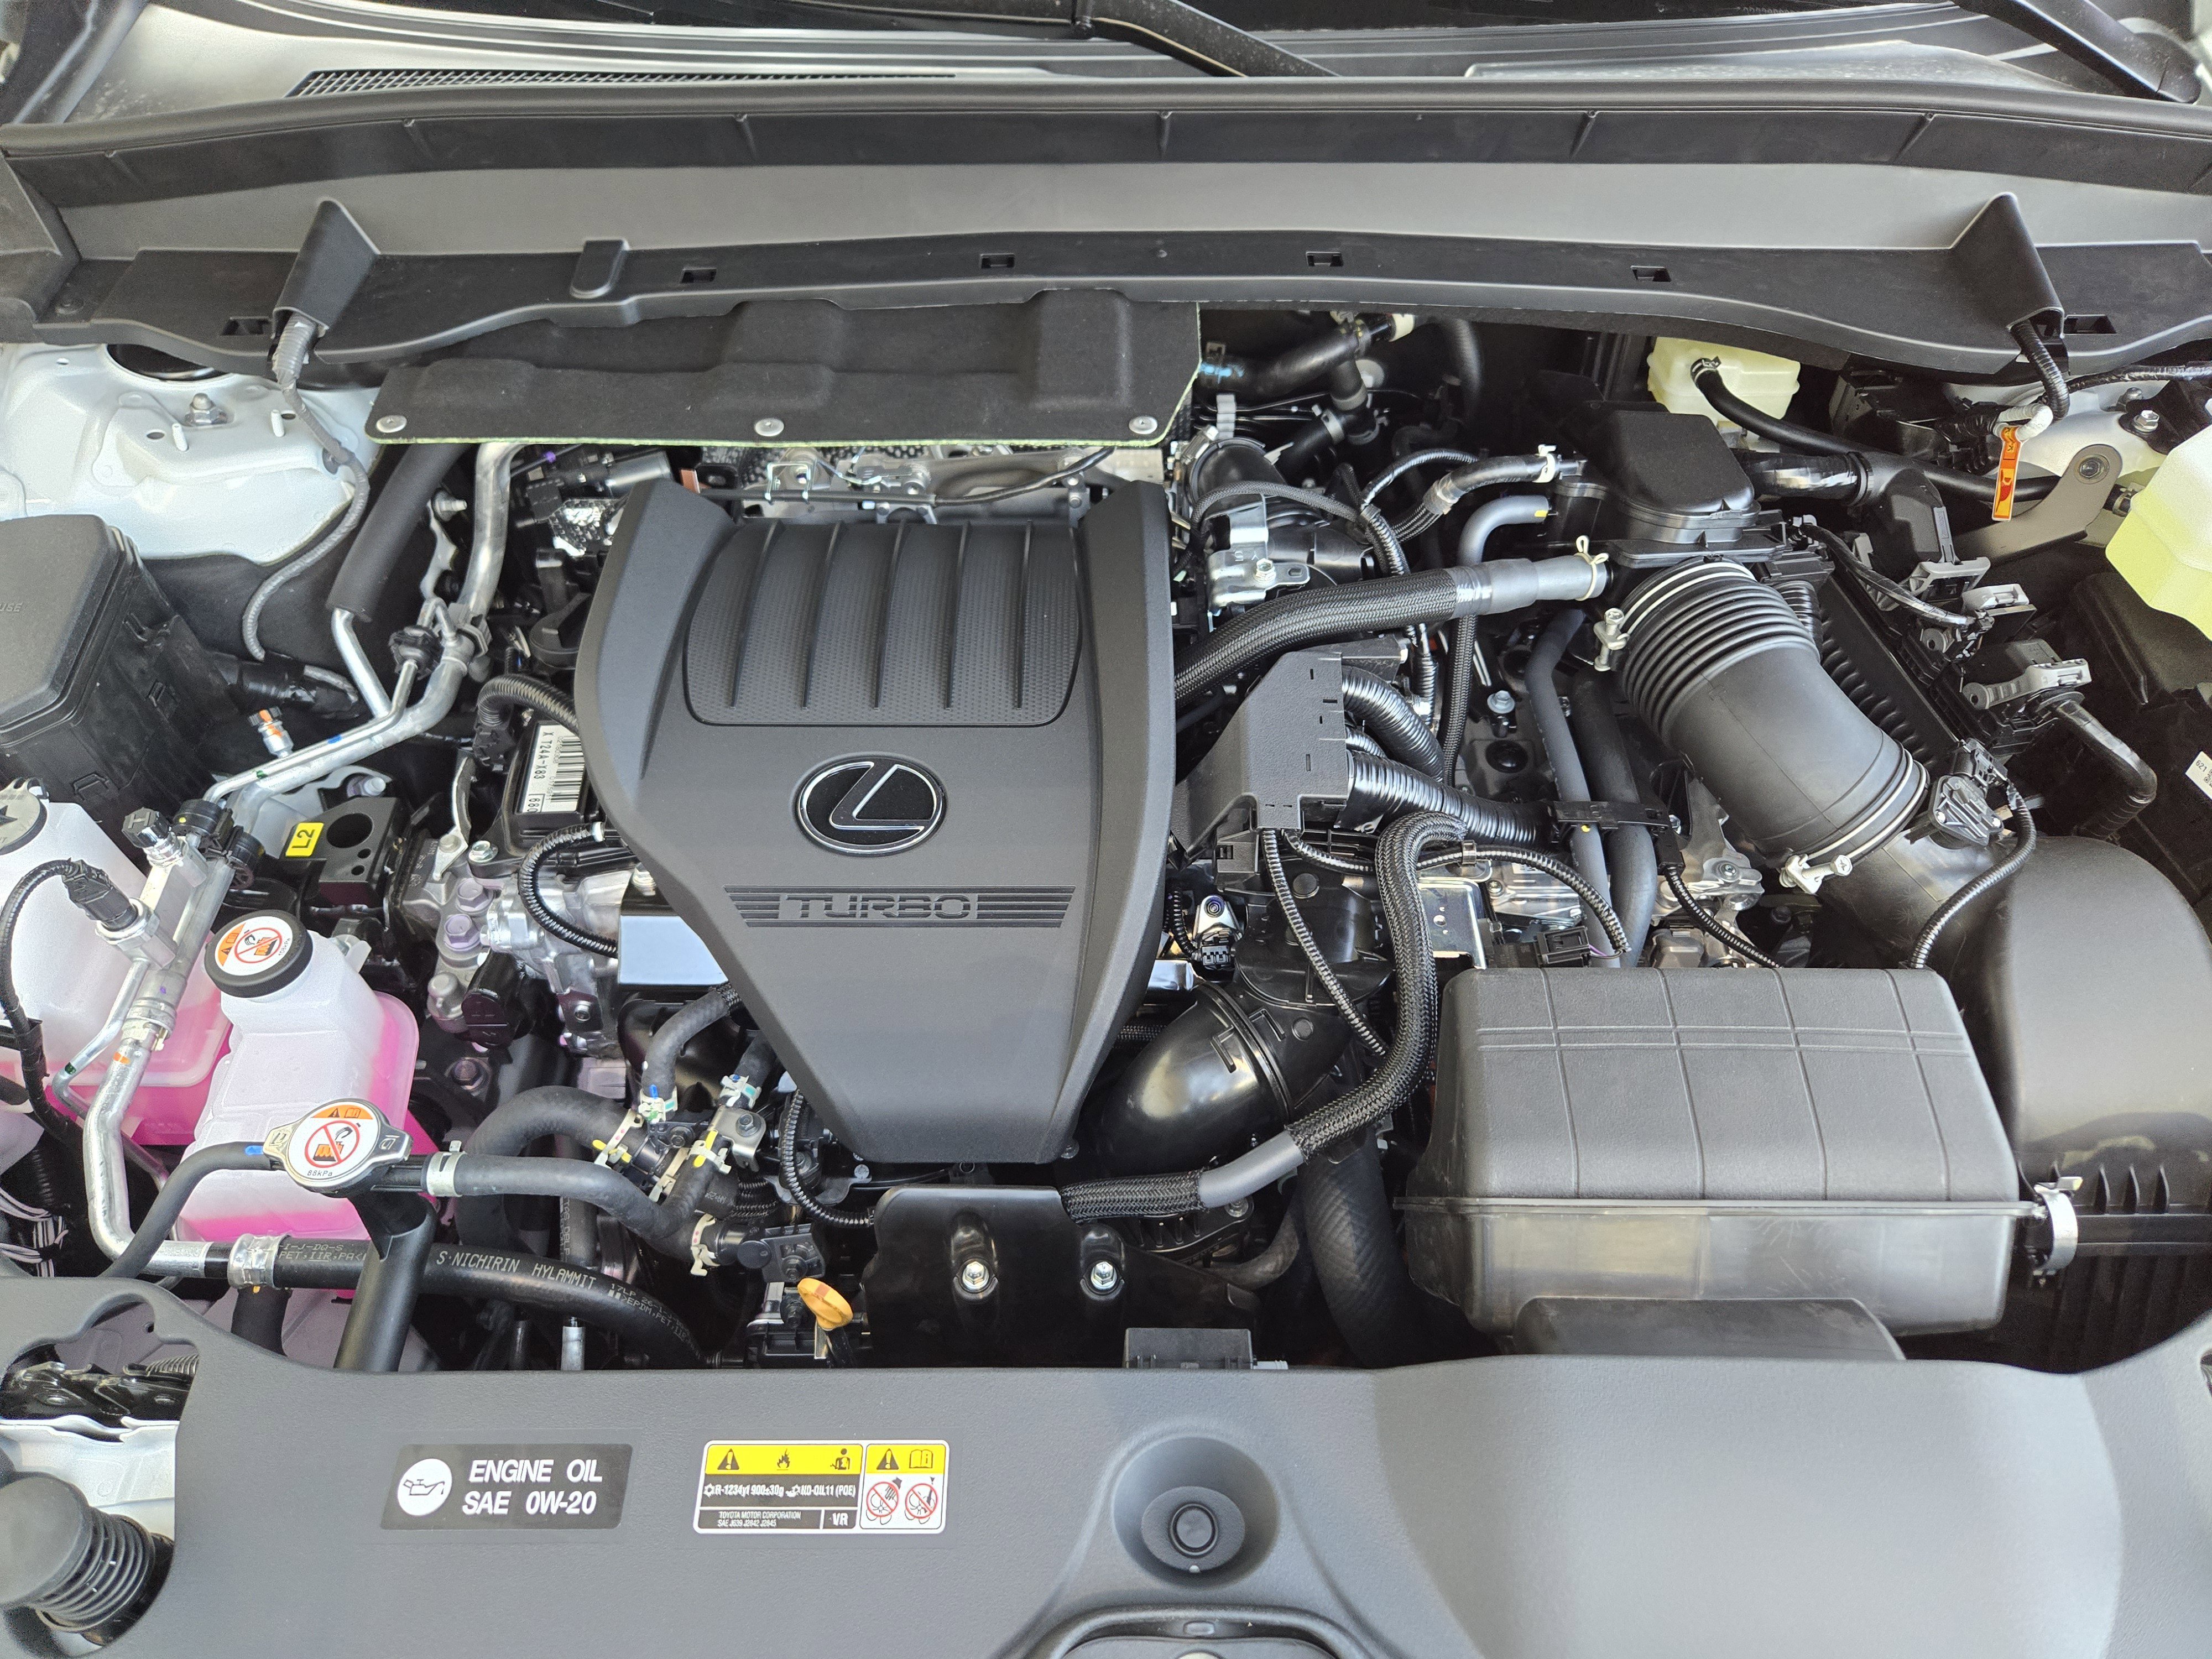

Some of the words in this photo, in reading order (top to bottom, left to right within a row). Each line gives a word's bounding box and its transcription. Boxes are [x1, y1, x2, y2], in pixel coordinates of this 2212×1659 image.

[533, 739, 553, 780] T24A-X83
[2195, 759, 2208, 773] 621
[291, 828, 316, 849] L2
[785, 894, 971, 919] TURBO
[531, 1262, 597, 1290] HYLAMMIT
[611, 1283, 637, 1297] 17LP
[468, 1459, 554, 1483] ENGINE
[566, 1458, 603, 1483] OIL
[801, 1484, 834, 1496] ND-OIL11
[836, 1484, 856, 1498] (POE)
[462, 1490, 512, 1515] SAE
[525, 1490, 597, 1515] 0W-20
[718, 1511, 740, 1519] TOYOTA
[741, 1511, 761, 1519] MOTOR
[762, 1511, 801, 1520] CORPORATION
[718, 1519, 729, 1527] SAE
[832, 1512, 849, 1526] VR
